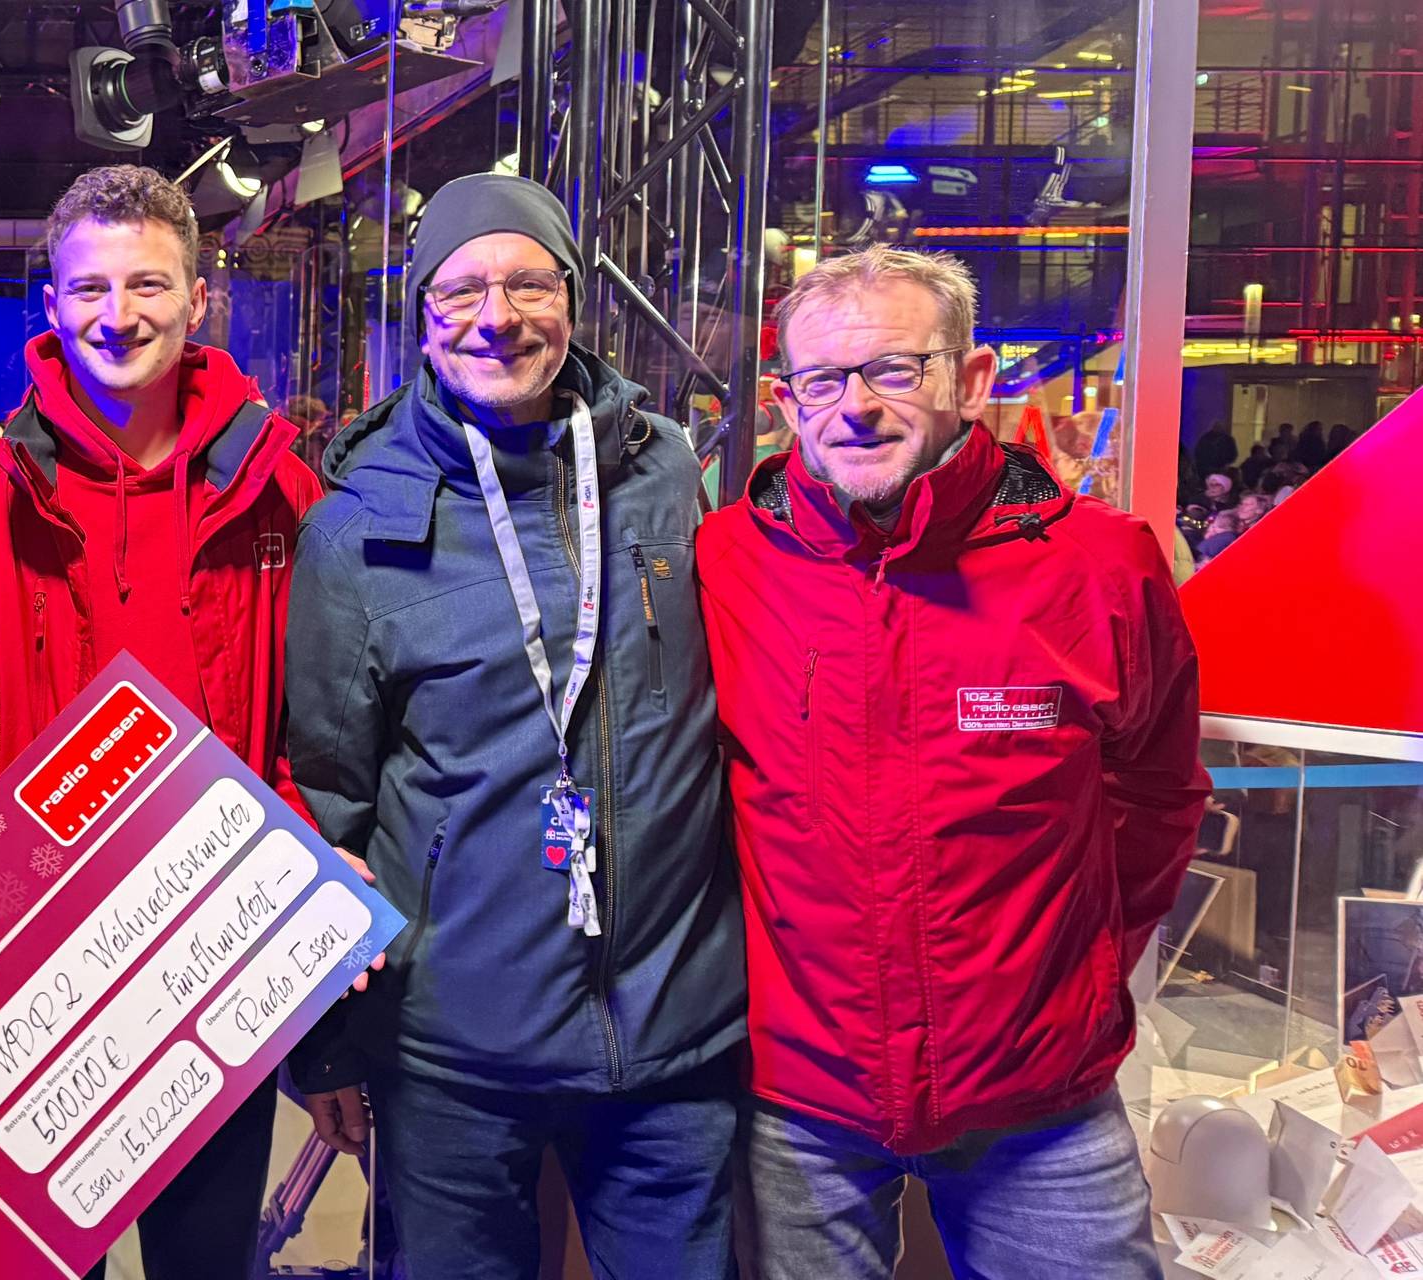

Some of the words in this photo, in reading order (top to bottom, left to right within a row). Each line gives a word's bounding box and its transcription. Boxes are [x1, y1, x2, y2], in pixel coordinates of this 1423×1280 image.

[964, 692, 1005, 702] 102.2
[972, 702, 1011, 712] radio
[1012, 702, 1055, 712] essen
[39, 763, 89, 814] radio
[90, 706, 145, 762] essen
[54, 972, 83, 1010] 2
[82, 803, 251, 969] Weihnachtswunder
[31, 1056, 107, 1145] 500,00
[103, 1036, 130, 1070] €
[162, 880, 277, 1006] fünfhundert
[205, 987, 243, 1026] Überbringer
[235, 975, 294, 1038] Radio
[288, 924, 349, 978] Essen
[4, 1110, 27, 1133] Betrag
[25, 1103, 33, 1112] in
[46, 1063, 70, 1087] Betrag
[66, 1057, 75, 1067] in
[72, 1034, 97, 1058] Worten
[104, 1113, 127, 1137] Datum
[71, 1168, 126, 1215] Essen,
[119, 1057, 210, 1164] 15.12.2025
